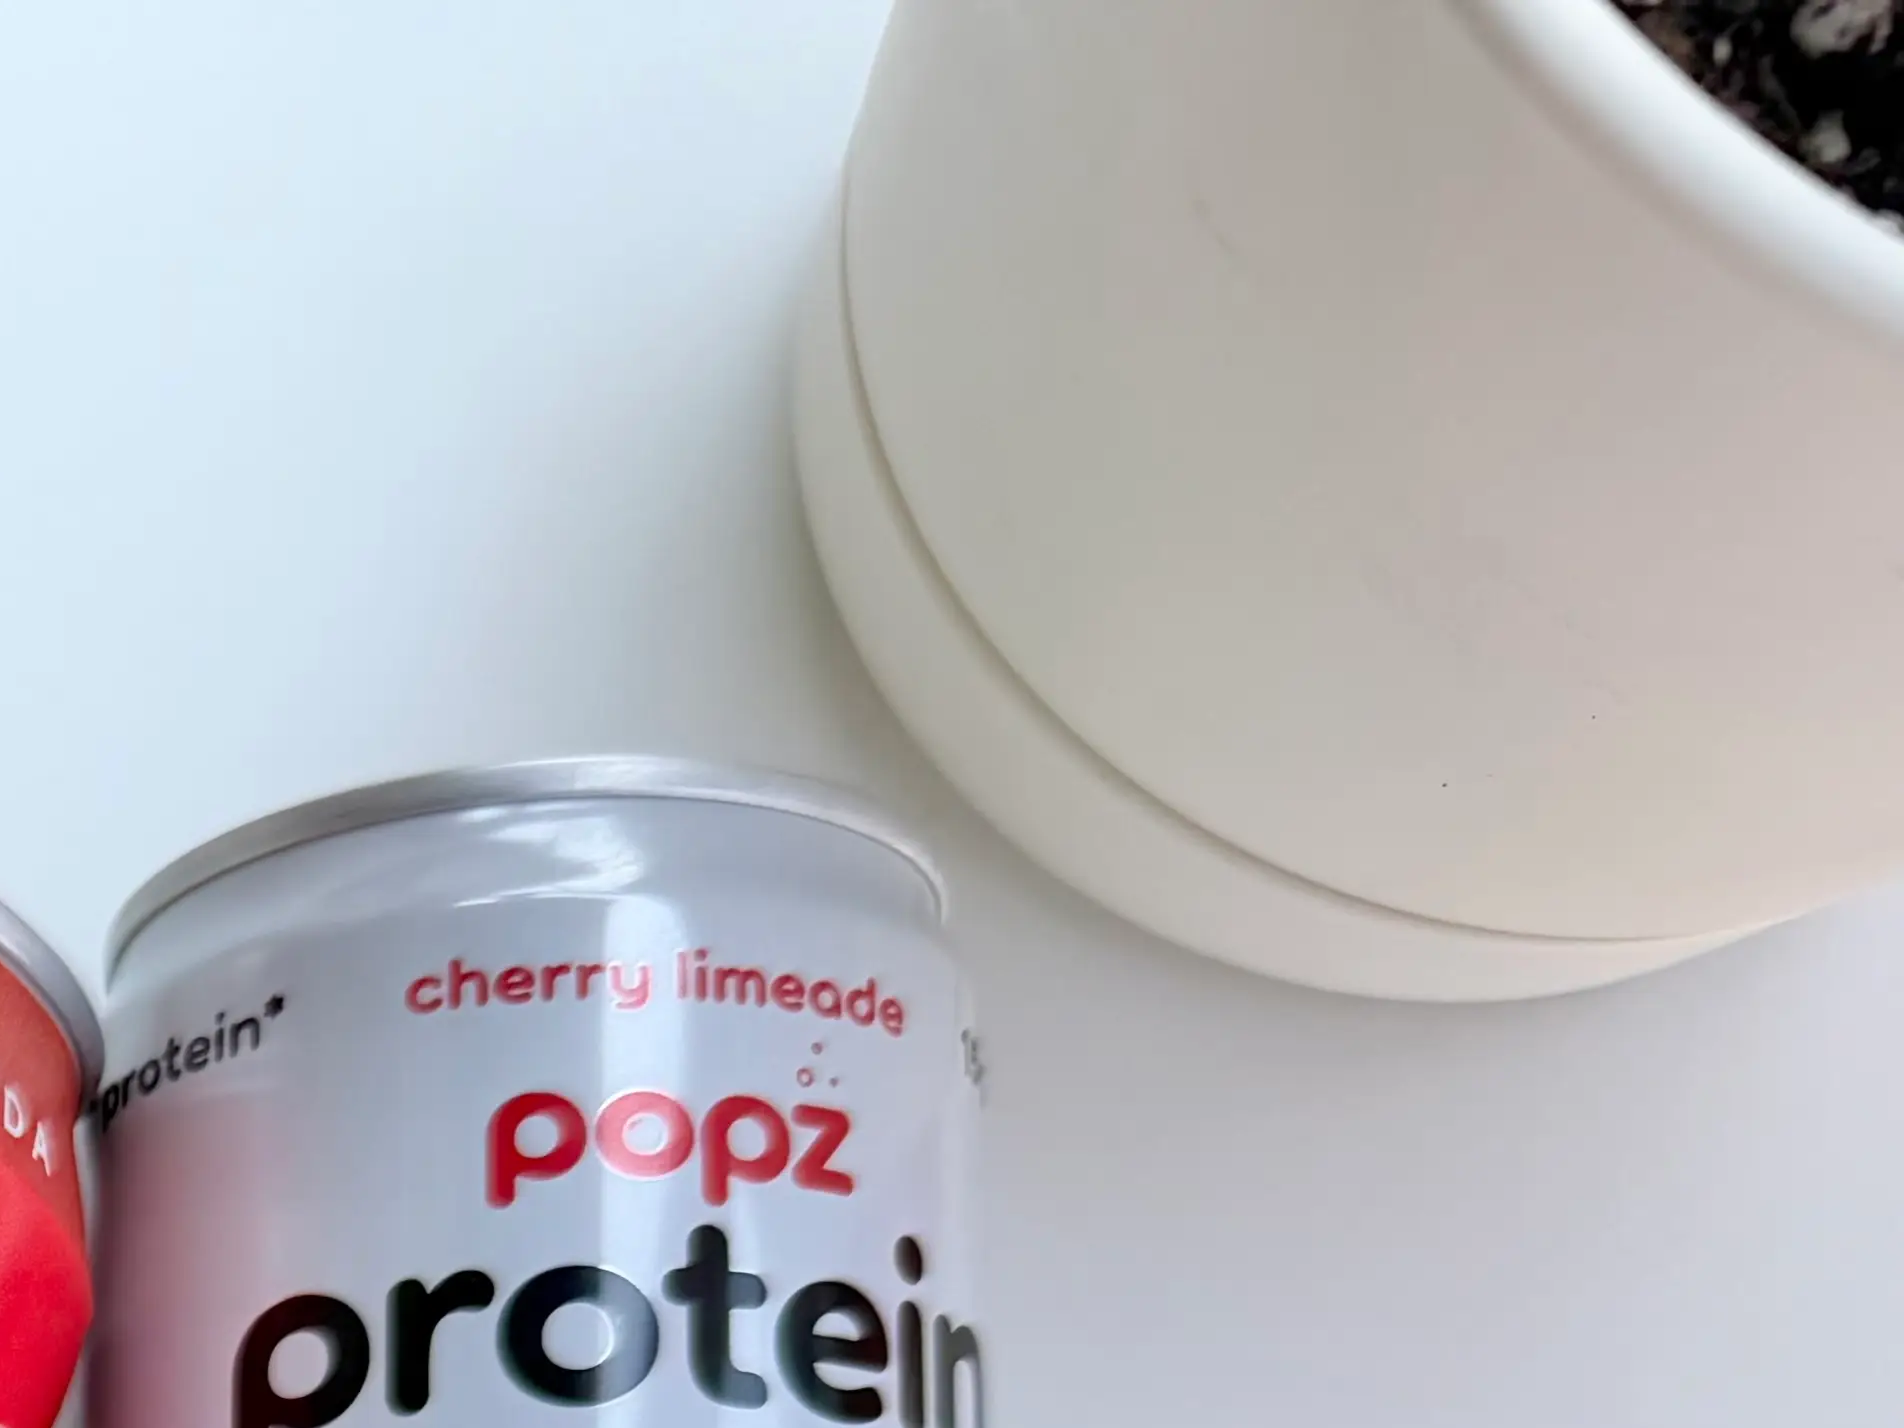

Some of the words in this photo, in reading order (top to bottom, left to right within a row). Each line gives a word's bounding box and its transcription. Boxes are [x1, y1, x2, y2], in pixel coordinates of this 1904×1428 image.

[405, 949, 653, 1014] cherry
[675, 950, 907, 1037] limeade
[487, 1090, 855, 1209] popz
